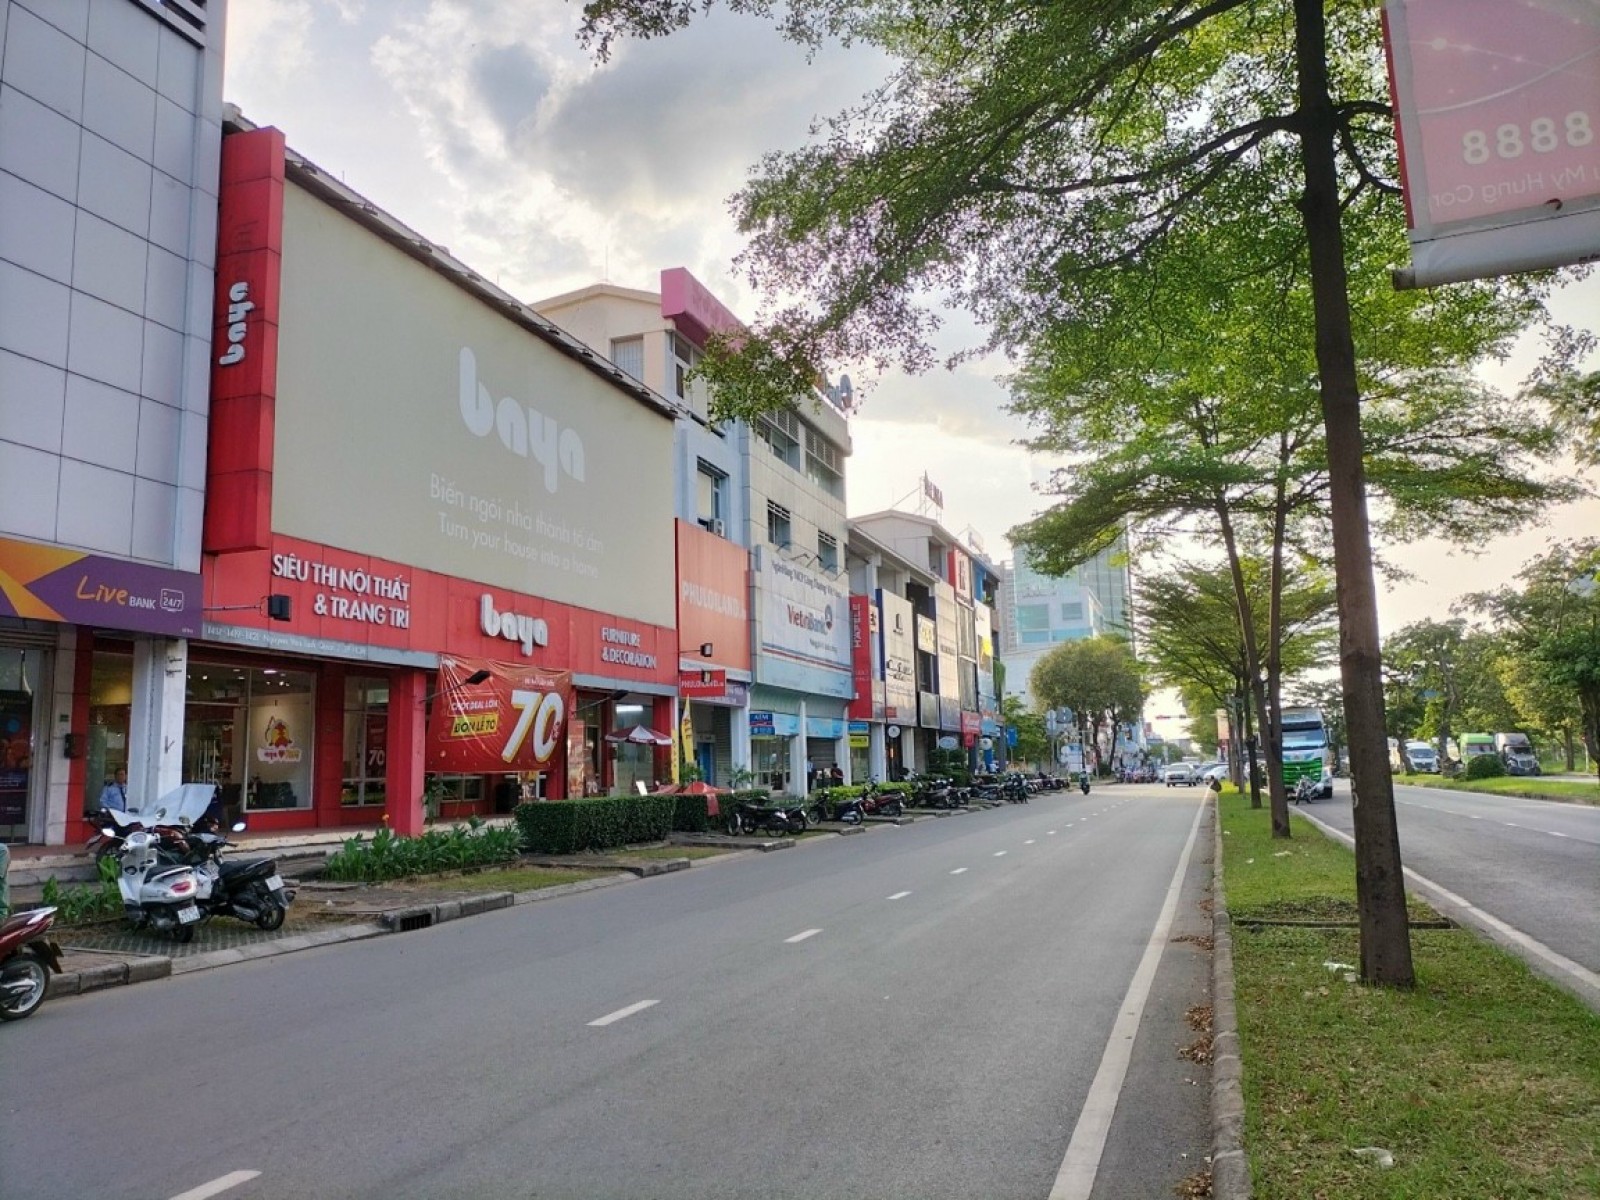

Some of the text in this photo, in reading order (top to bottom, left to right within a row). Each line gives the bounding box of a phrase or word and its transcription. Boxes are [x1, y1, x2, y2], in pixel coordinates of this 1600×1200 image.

[219, 281, 255, 364] baya
[459, 346, 585, 494] baya
[438, 511, 468, 540] Turn
[471, 529, 501, 551] your
[76, 575, 129, 606] Live
[129, 595, 156, 611] BANK
[272, 553, 410, 602] SIÊU THỊ NỘI THẤT
[314, 592, 328, 616] &
[330, 595, 387, 625] TRANG
[480, 593, 548, 657] baya
[501, 690, 564, 763] 70
[368, 749, 386, 767] 70
